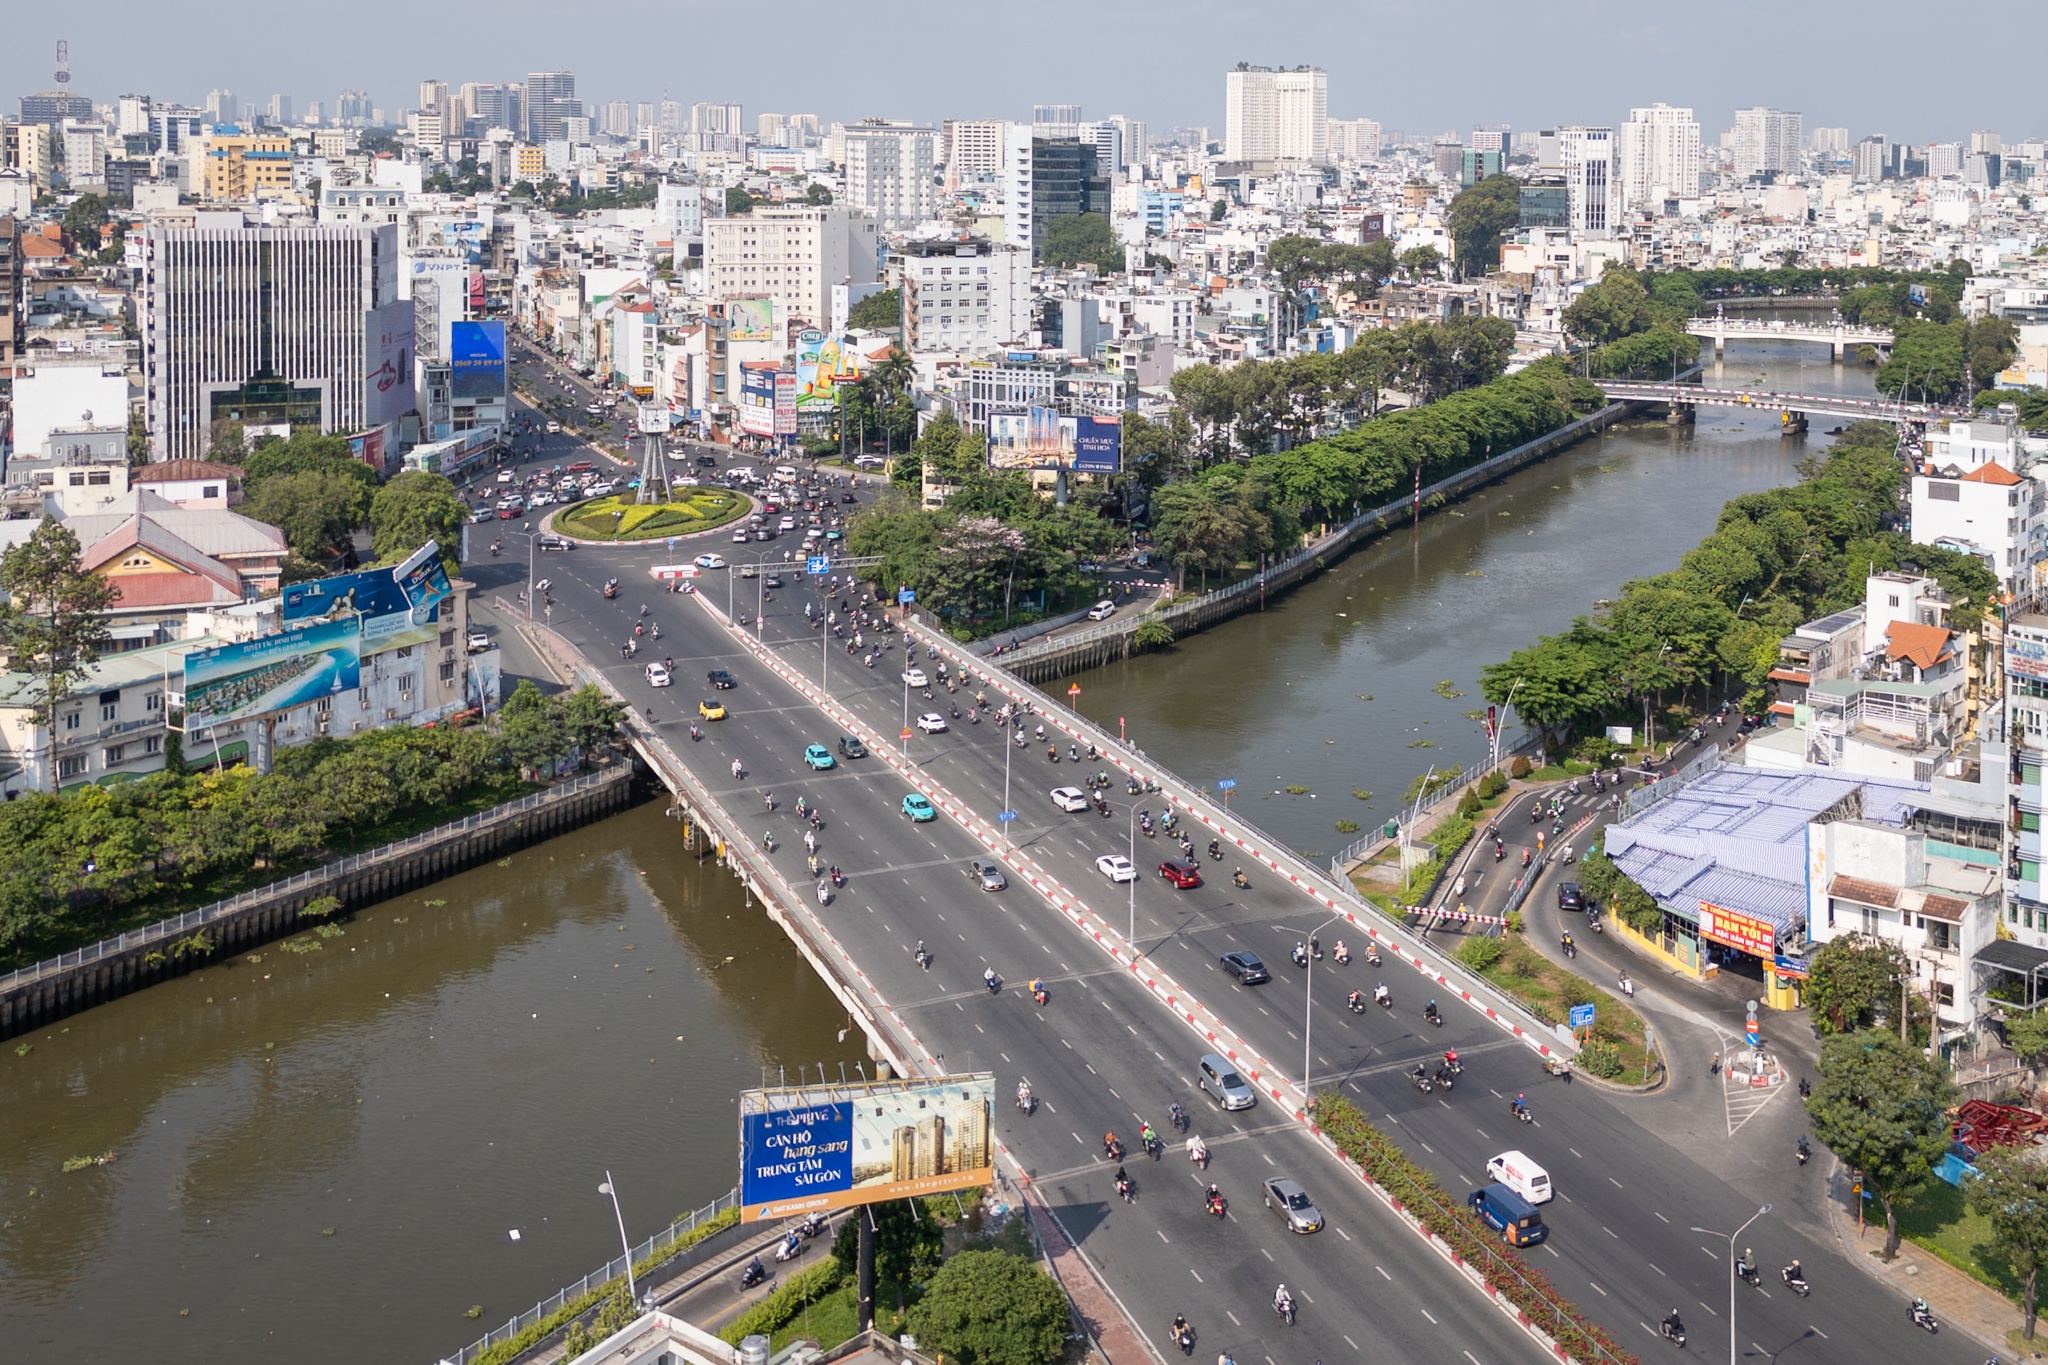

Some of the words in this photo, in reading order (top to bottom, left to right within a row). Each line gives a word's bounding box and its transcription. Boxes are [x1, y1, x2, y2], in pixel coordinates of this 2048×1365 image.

[801, 332, 821, 341] Cozy
[411, 566, 433, 584] Dulux
[1740, 925, 1761, 941] TÔI
[793, 1129, 812, 1145] HỘ
[783, 1145, 817, 1160] hạng
[817, 1140, 849, 1154] sang
[756, 1162, 797, 1179] TRUNG
[797, 1158, 823, 1172] TÂM
[795, 1172, 813, 1187] SÀI
[814, 1169, 841, 1184] GÒN
[805, 1198, 829, 1208] GROUP
